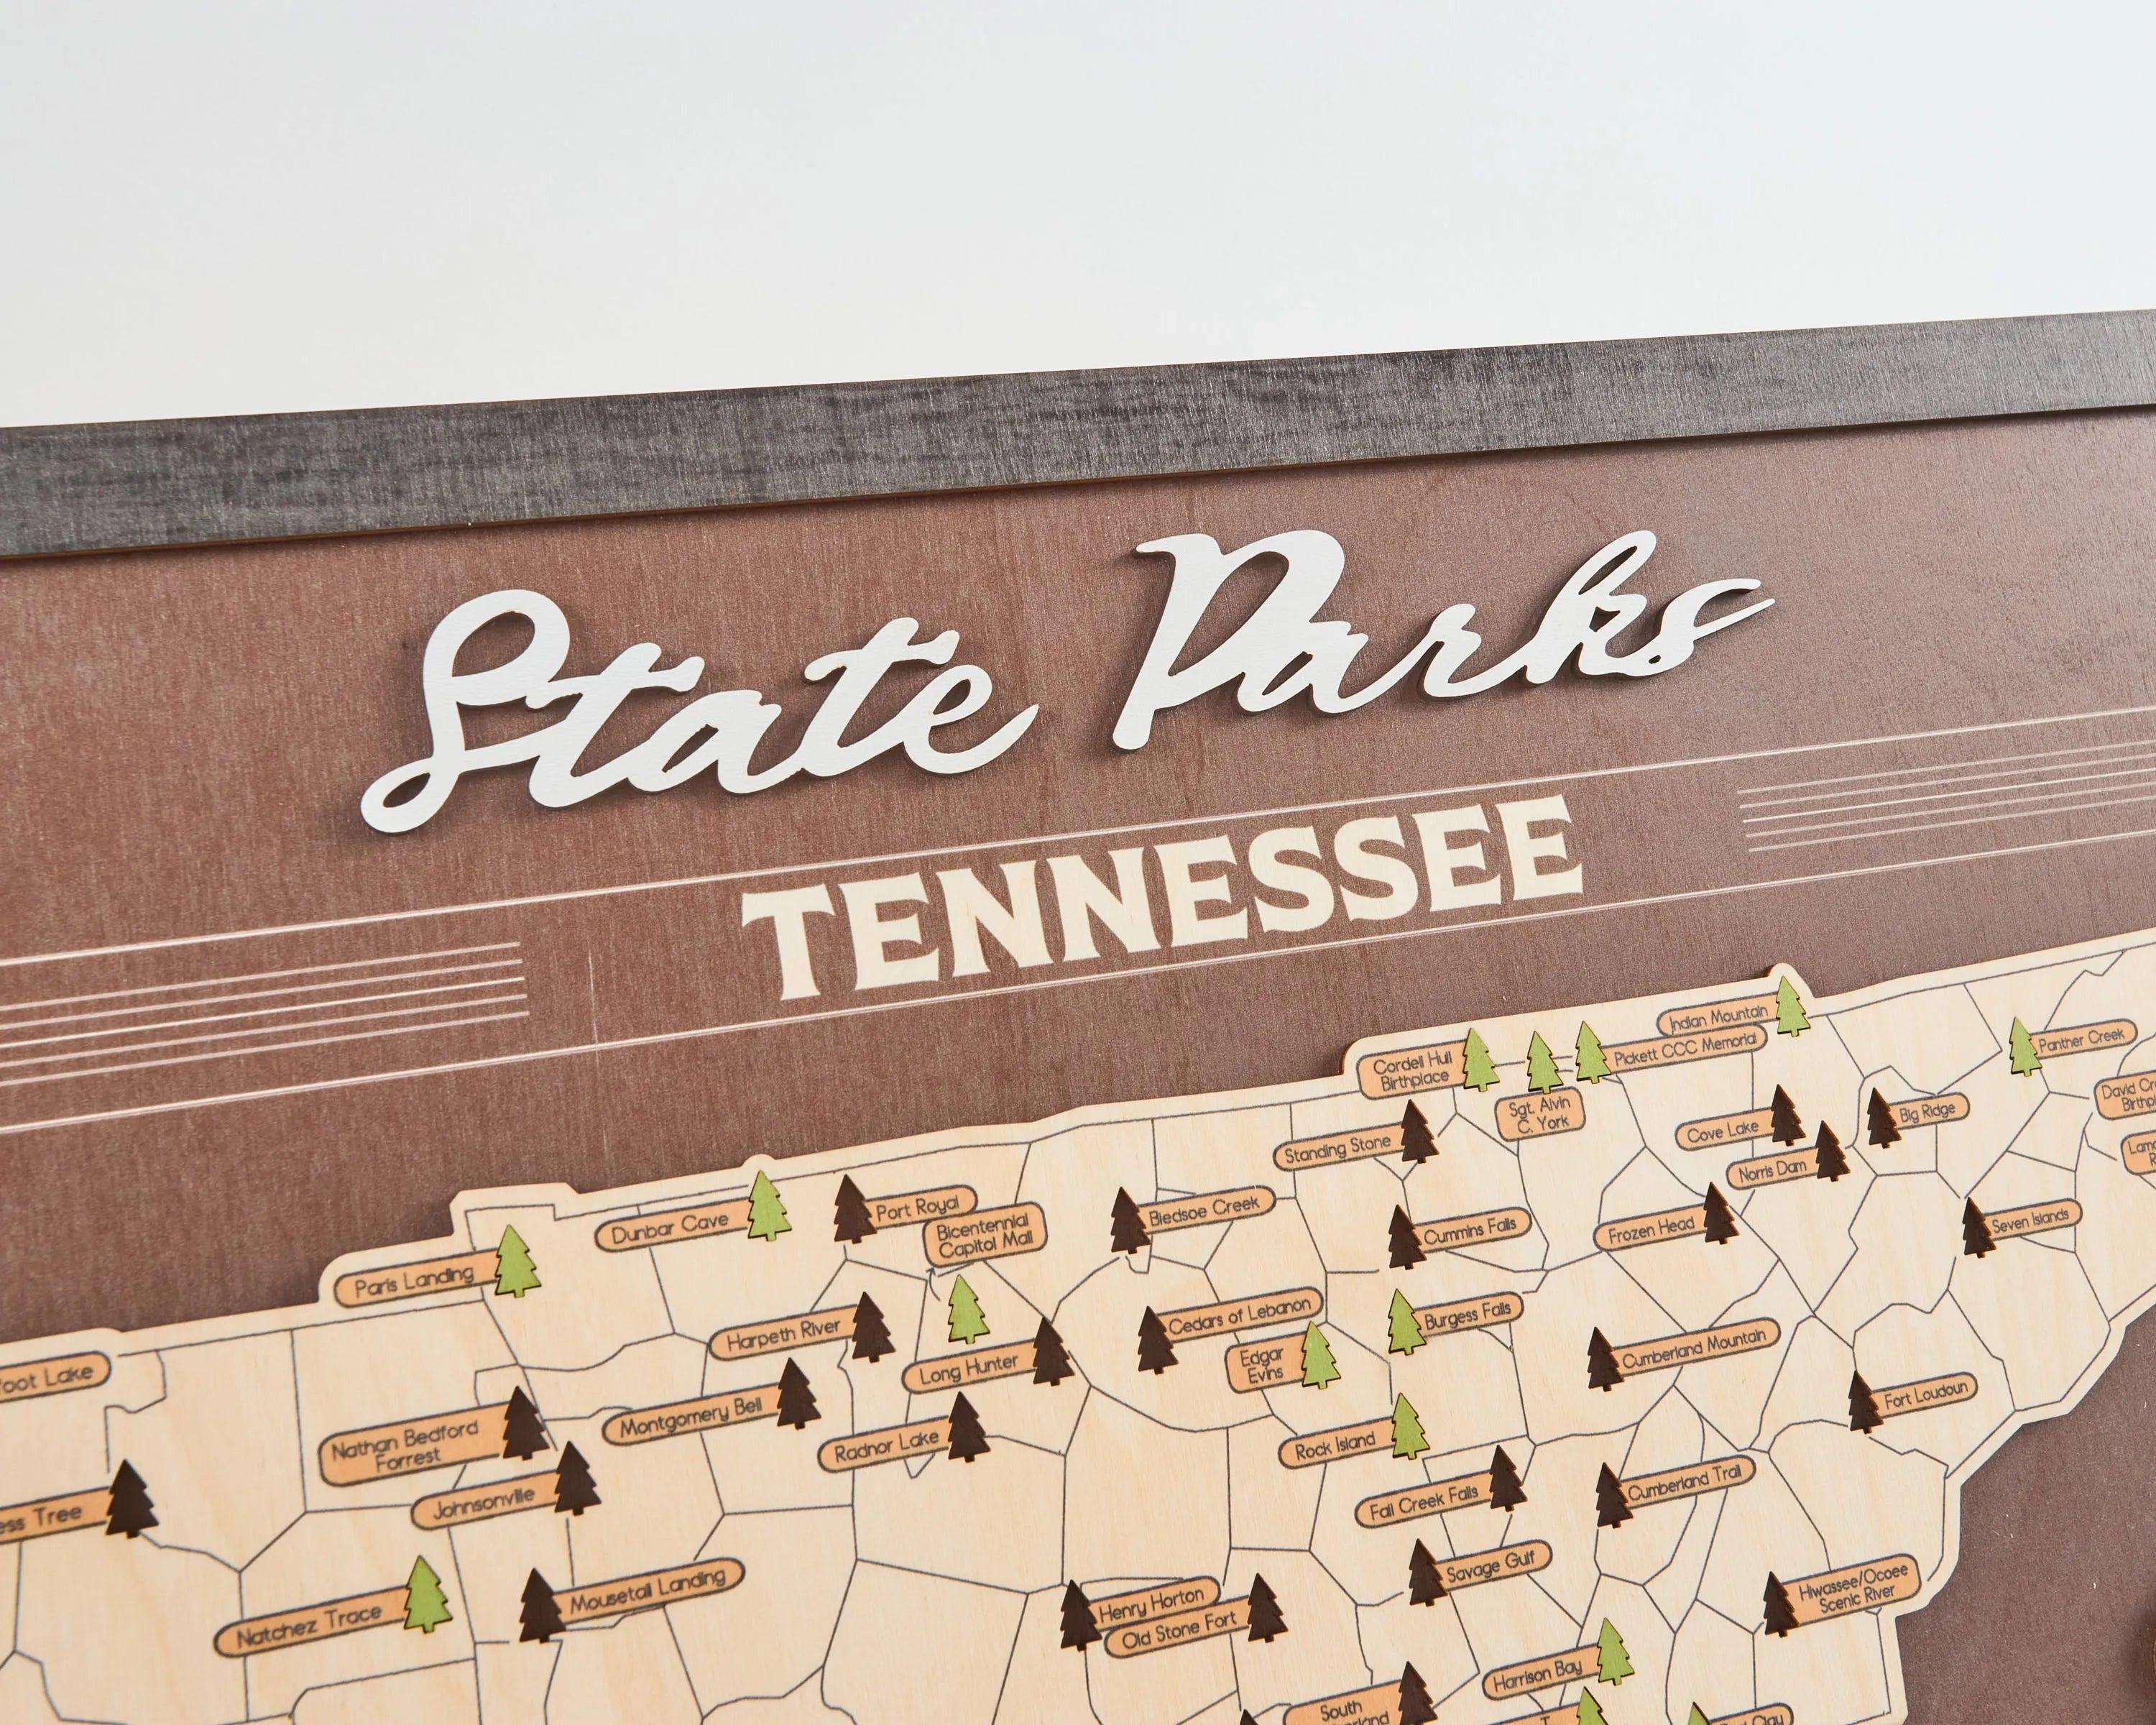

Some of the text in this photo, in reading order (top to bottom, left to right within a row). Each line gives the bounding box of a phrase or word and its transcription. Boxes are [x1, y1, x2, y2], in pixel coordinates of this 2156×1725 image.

[361, 530, 1775, 832] State Parks
[742, 794, 1583, 1000] TENNESSEE
[1669, 1006, 1768, 1032] Indian Mountain
[1614, 1033, 1757, 1067] Pickett CCC Memorial
[2039, 1029, 2124, 1053] Panther Creek
[1373, 1051, 1452, 1075] Cordell Hull
[1381, 1071, 1449, 1092] Birthplace
[2101, 1082, 2136, 1099] David
[1508, 1096, 1570, 1119] Sgt. Alvin
[1899, 1101, 1955, 1123] Big Ridge
[1517, 1115, 1569, 1133] C. York
[1687, 1122, 1759, 1143] Cove Lake
[1285, 1136, 1391, 1164] Standing Stone
[1739, 1161, 1807, 1183] Norris Dam
[877, 1196, 959, 1222] Port Royal
[1149, 1196, 1260, 1226] Bledsoe Creek
[1992, 1209, 2069, 1233] Seven Islands
[612, 1215, 729, 1244] Dunbar Cave
[937, 1213, 1028, 1241] Bicentennial
[1424, 1218, 1516, 1245] Cummins Falls
[1608, 1216, 1695, 1243] Frozen Head
[939, 1230, 1033, 1259] Capitol Mall
[356, 1265, 475, 1297] Paris Landing
[1169, 1299, 1311, 1335] Cedars of Lebanon
[1425, 1302, 1511, 1332] Burgess Falls
[727, 1320, 840, 1351] Harpeth River
[1623, 1329, 1766, 1368] Cumberland Mountain
[921, 1356, 1018, 1385] Long Hunter
[1240, 1348, 1284, 1370] Edgar
[0, 1367, 93, 1394] oot Lake
[1248, 1366, 1284, 1384] Evins
[1884, 1382, 1968, 1409] Fort Loudoun
[620, 1397, 763, 1438] Montgomery Bell
[331, 1420, 479, 1459] Nathan Bedford
[835, 1432, 939, 1463] Radnor Lake
[1295, 1431, 1376, 1460] Rock Island
[376, 1448, 441, 1471] Forrest
[1628, 1464, 1741, 1501] Cumberland Trail
[33, 1507, 82, 1525] Tree
[434, 1489, 535, 1519] Johnsonville
[1370, 1486, 1478, 1521] Fall Creek Falls
[1447, 1550, 1534, 1583] Savage Gulf
[571, 1569, 725, 1614] Mousetail Landing
[1799, 1564, 1908, 1601] Hiwassee/Ocoee
[1099, 1589, 1204, 1623] Henry Horton
[1820, 1586, 1894, 1614] Scenic River
[237, 1606, 382, 1647] Natchez Trace
[1123, 1611, 1236, 1649] Old Stone Fort
[1493, 1660, 1582, 1692] Harrison Bay
[1320, 1701, 1362, 1721] South
